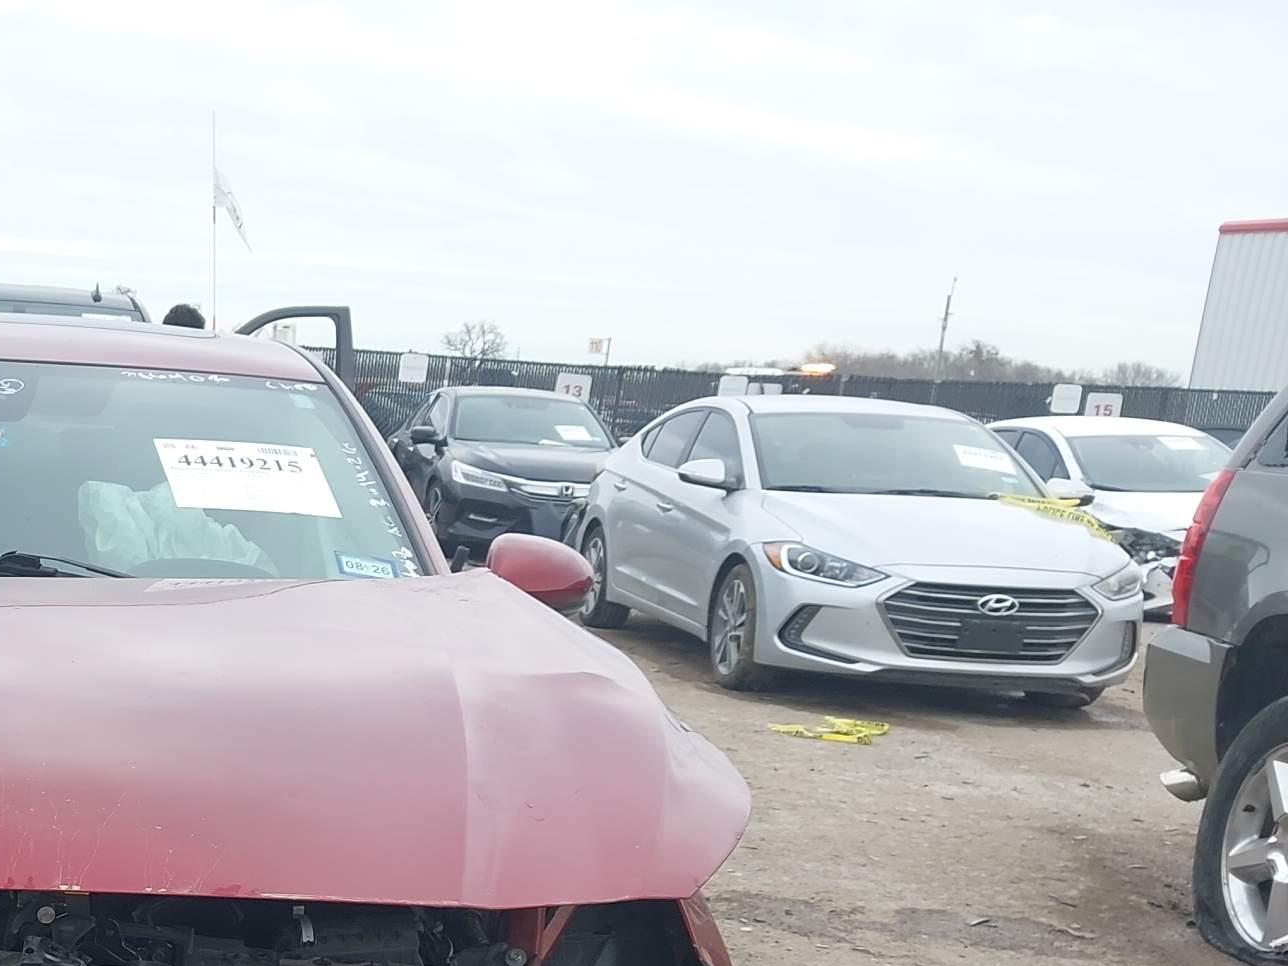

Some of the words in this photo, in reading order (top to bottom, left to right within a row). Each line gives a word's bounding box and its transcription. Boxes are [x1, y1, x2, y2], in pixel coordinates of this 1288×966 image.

[564, 385, 583, 397] 13
[1095, 404, 1113, 416] 15
[178, 454, 302, 473] 44419215
